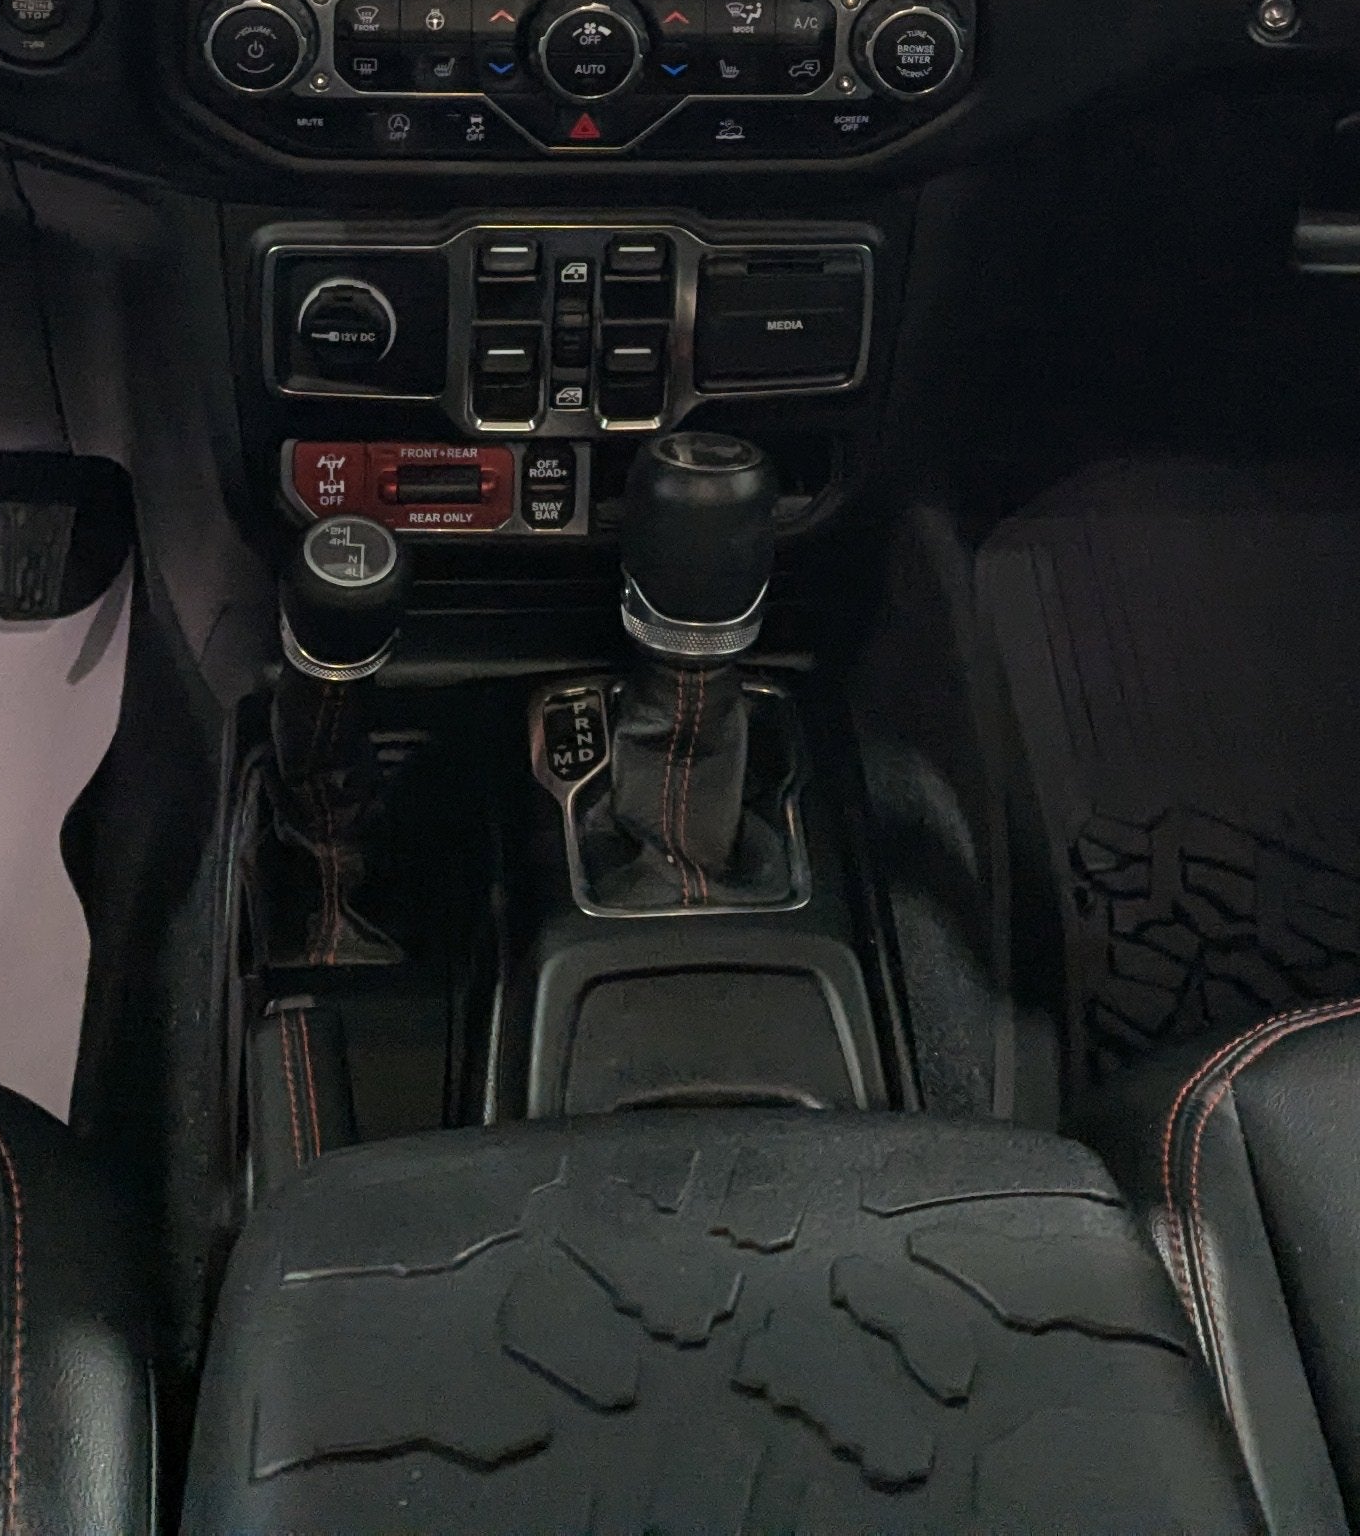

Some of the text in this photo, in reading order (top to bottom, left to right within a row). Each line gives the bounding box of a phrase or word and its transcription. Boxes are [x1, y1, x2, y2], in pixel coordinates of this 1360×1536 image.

[12, 1, 54, 11] ENGINE
[19, 11, 50, 20] STOP
[353, 24, 379, 32] FRONT
[794, 16, 818, 30] A/C
[732, 25, 755, 34] MODE
[579, 35, 602, 46] OFF
[897, 44, 935, 54] BROWSE
[901, 55, 931, 64] ENTER
[574, 64, 606, 75] AUTO
[296, 118, 324, 127] MUTE
[833, 115, 869, 124] SCREEN
[841, 124, 859, 132] OFF
[465, 131, 485, 142] OFF
[767, 319, 804, 331] MEDIA
[341, 332, 376, 342] 12V DC
[537, 460, 559, 470] OFF
[319, 496, 344, 506] OFF
[531, 502, 563, 512] SWAY
[409, 513, 473, 524] REAR ONLY
[535, 511, 558, 520] BAR
[329, 537, 346, 546] 4H
[348, 555, 357, 563] N
[344, 568, 358, 577] 4L
[573, 702, 587, 714] P
[575, 718, 591, 730] R
[577, 731, 593, 746] N
[553, 751, 574, 766] M
[578, 748, 595, 762] D
